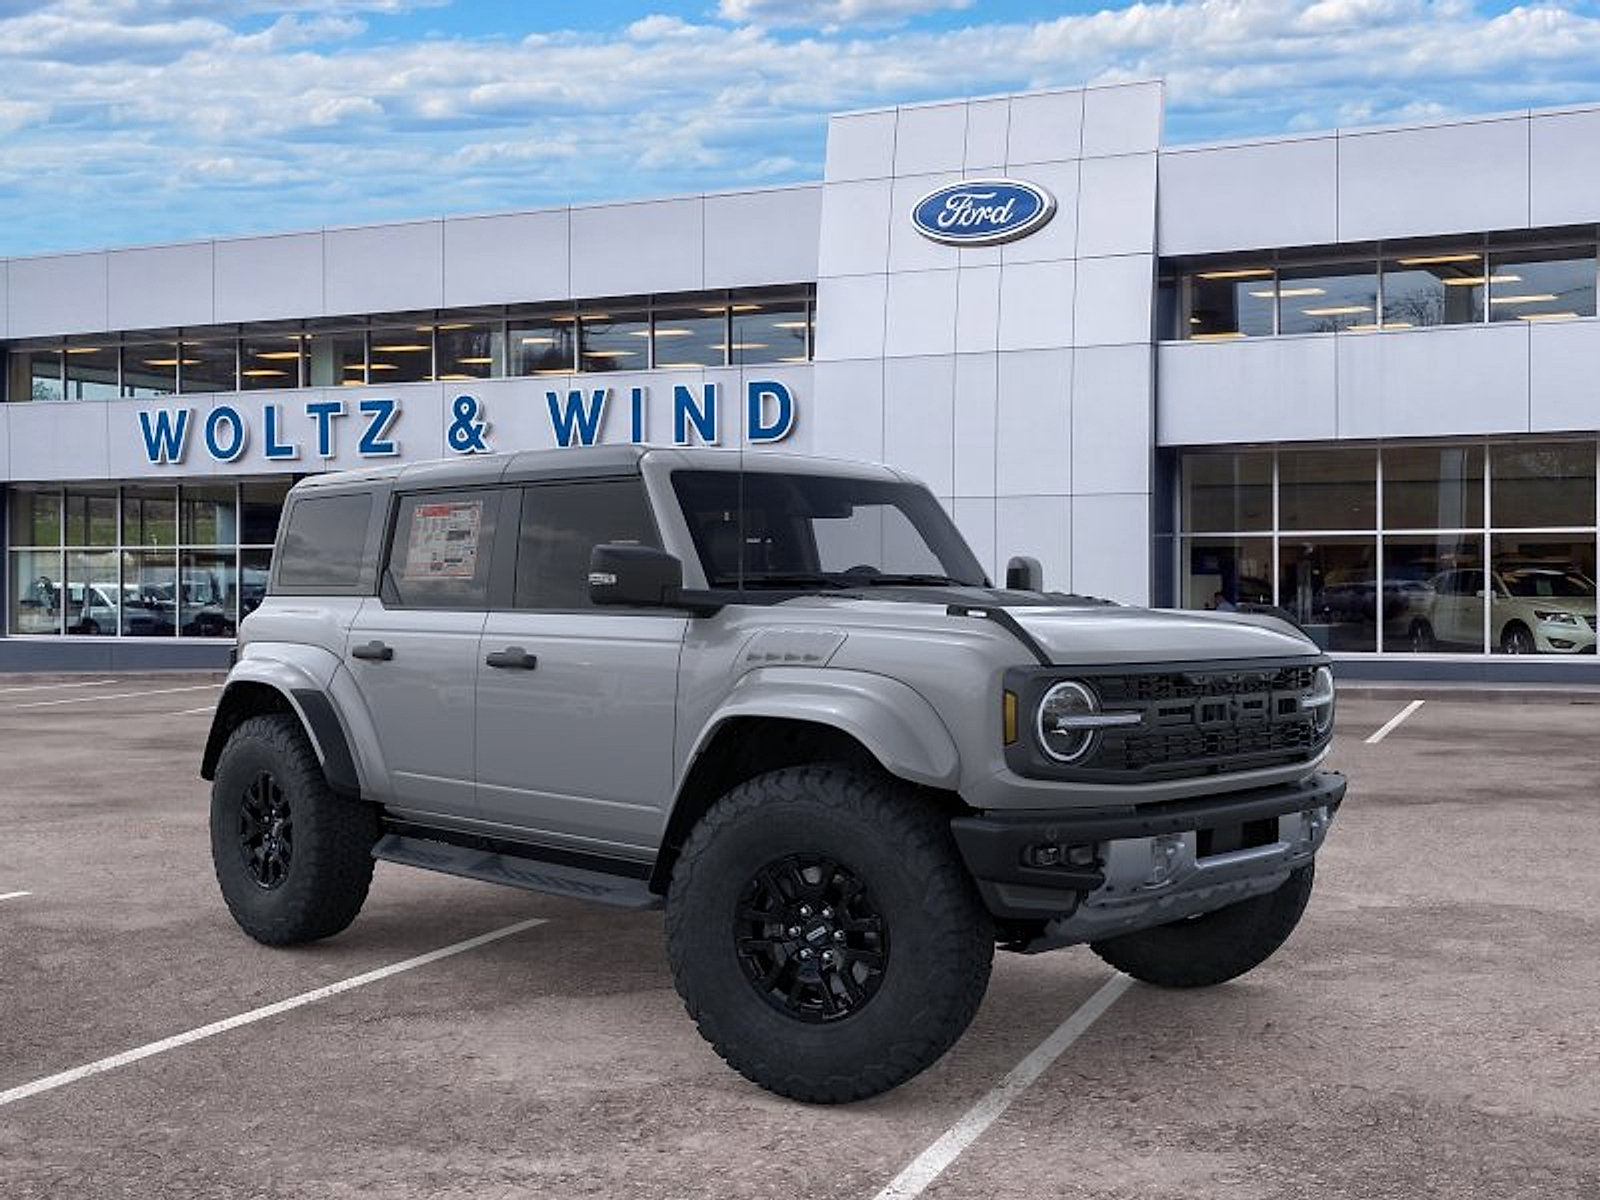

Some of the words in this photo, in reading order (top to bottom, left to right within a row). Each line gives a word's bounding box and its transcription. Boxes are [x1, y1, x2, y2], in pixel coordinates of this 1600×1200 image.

[937, 192, 1016, 227] Ford
[138, 397, 400, 464] WOLTZ
[447, 394, 490, 453] &
[546, 379, 796, 448] WIND
